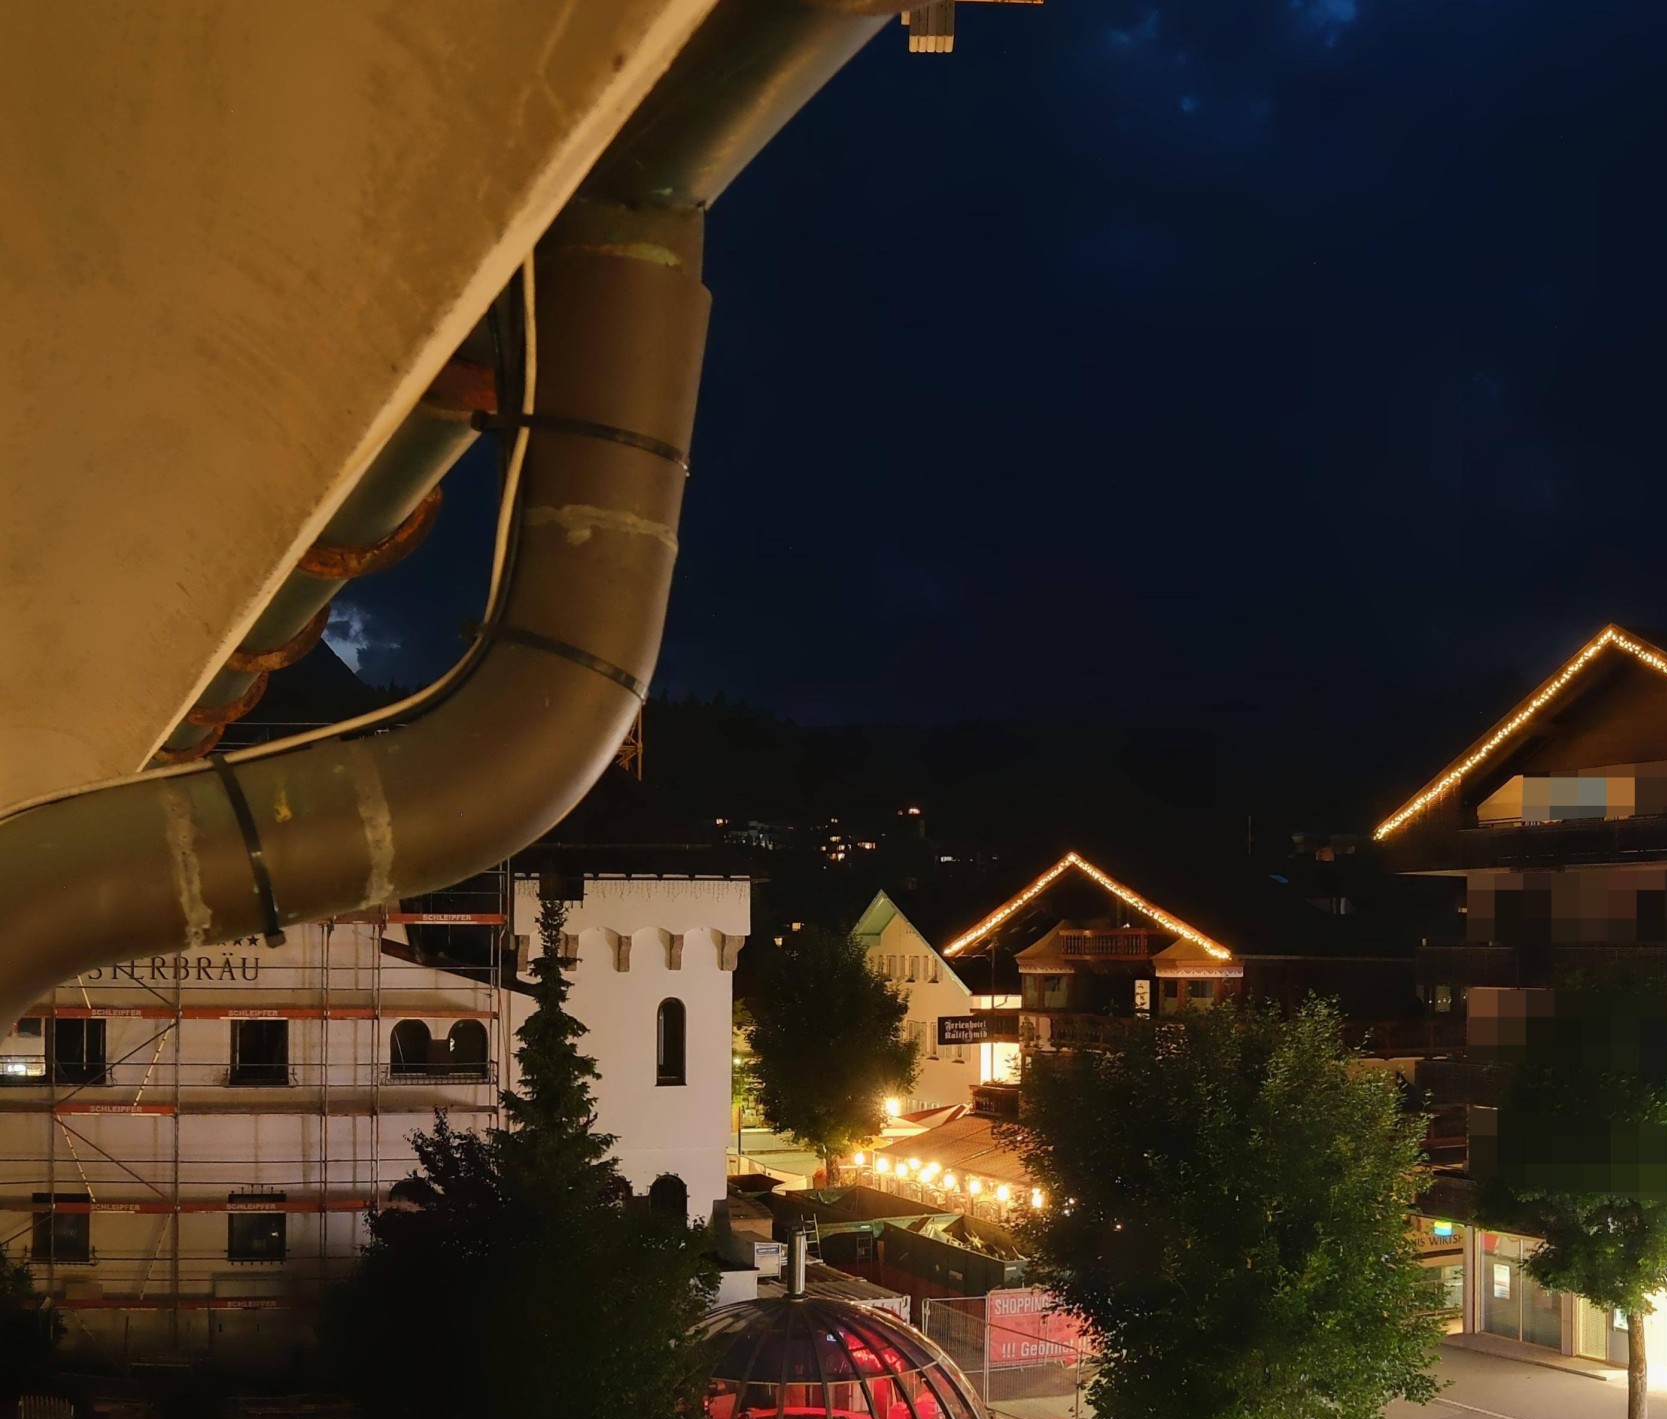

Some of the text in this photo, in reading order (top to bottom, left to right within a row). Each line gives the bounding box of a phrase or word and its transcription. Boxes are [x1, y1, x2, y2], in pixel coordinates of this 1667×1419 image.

[422, 914, 472, 922] SCHLEIPFER
[91, 1009, 142, 1018] SCHLEIPFER
[228, 1009, 279, 1018] SCHLEIPFER
[89, 1105, 143, 1114] SCHLEIPFER
[90, 1203, 140, 1212] SCHLEIPFER
[226, 1202, 276, 1211] SCHLEIPFER
[995, 1296, 1050, 1316] SHOPPING
